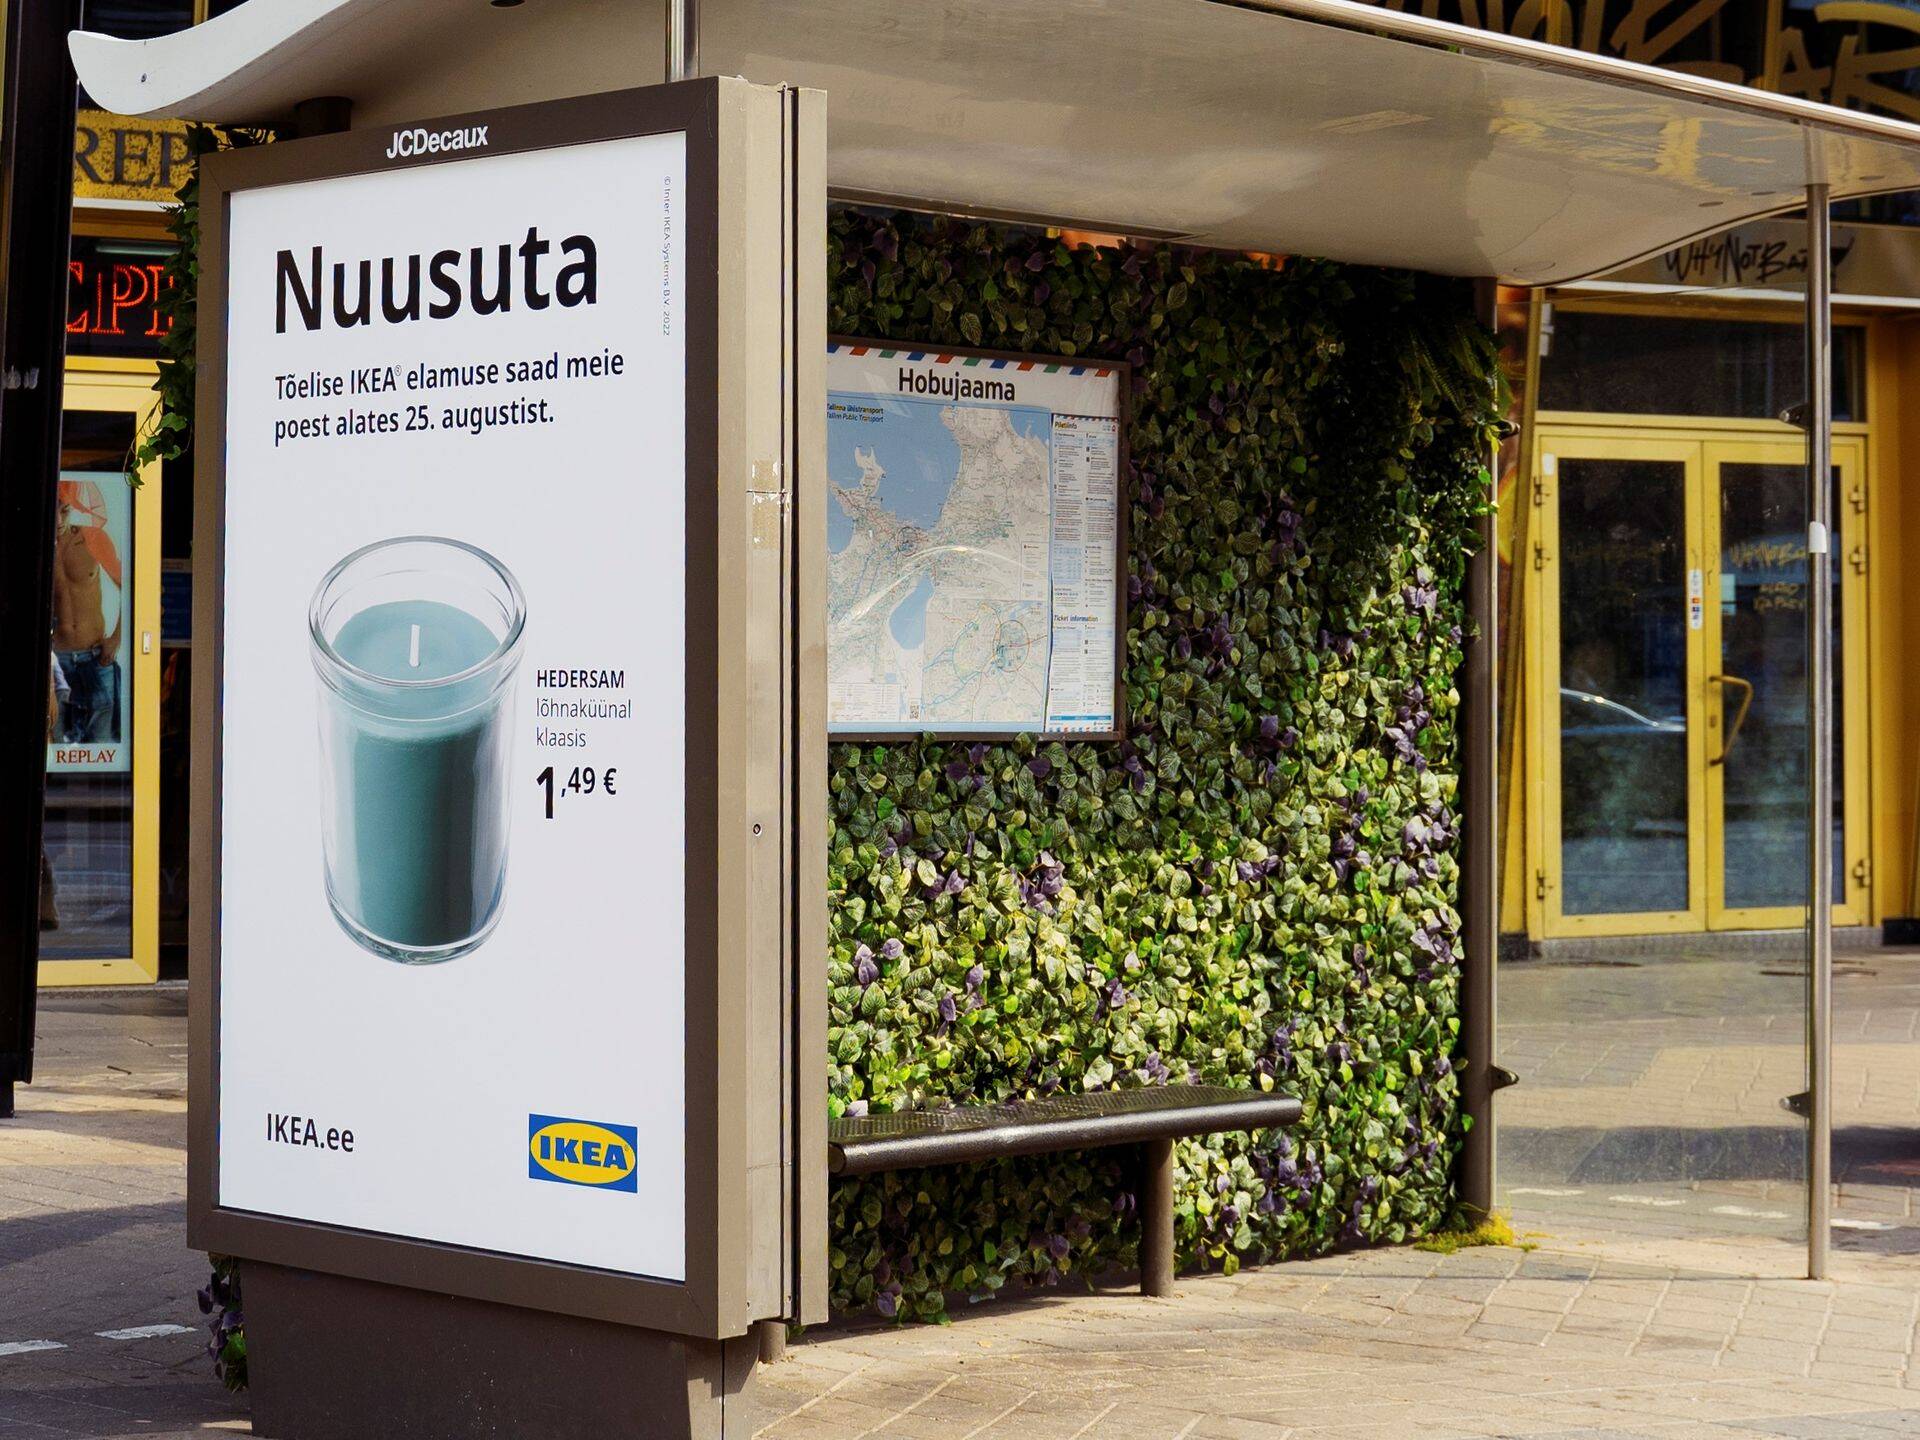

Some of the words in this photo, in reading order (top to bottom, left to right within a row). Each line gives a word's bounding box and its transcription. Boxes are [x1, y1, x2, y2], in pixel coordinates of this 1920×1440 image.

[386, 126, 489, 159] JCDecaux
[663, 188, 671, 214] Inter
[663, 216, 671, 241] IKEA
[661, 242, 671, 287] Systems
[275, 226, 598, 335] Nuusuta
[663, 310, 671, 336] 2022
[274, 373, 343, 401] Tõelise
[406, 362, 499, 391] elamuse
[505, 351, 559, 383] saad
[566, 348, 625, 379] meie
[898, 367, 1015, 402] Hobujaama
[274, 412, 330, 447] poest
[336, 408, 400, 435] alates
[405, 404, 435, 431] 25.
[442, 397, 555, 435] augustist.
[536, 669, 625, 689] HEDERSAM
[536, 697, 632, 719] lõhnaküünal
[536, 726, 587, 748] klaasis
[56, 749, 117, 764] REPLAY
[603, 767, 617, 796] €
[266, 1112, 355, 1153] IKEA.ee
[539, 1135, 629, 1171] IKEA
